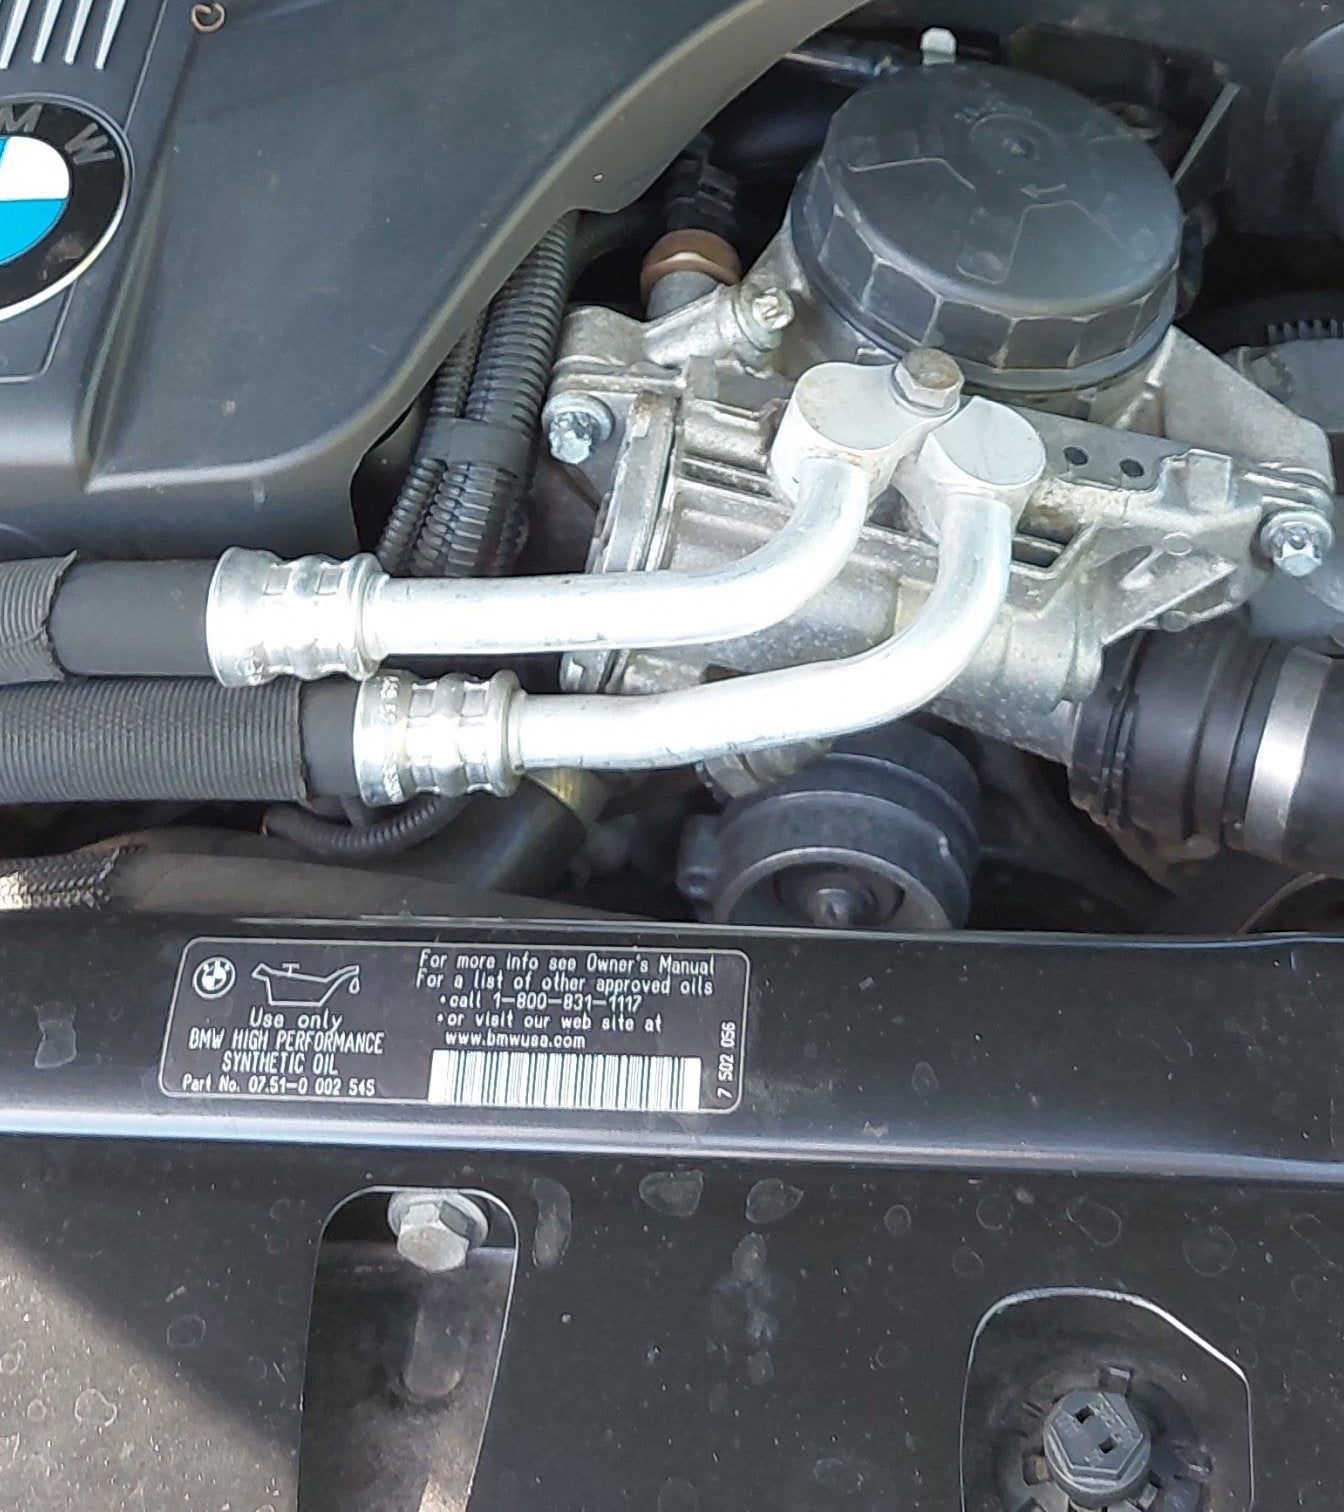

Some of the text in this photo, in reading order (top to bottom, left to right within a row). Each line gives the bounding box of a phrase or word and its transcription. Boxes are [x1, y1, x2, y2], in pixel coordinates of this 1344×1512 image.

[419, 949, 447, 969] For
[457, 954, 495, 970] more
[549, 956, 576, 972] see
[587, 954, 648, 974] Owner's
[659, 955, 715, 976] Manual
[416, 970, 713, 997] For a list of other approved oils
[493, 993, 643, 1013] 1-800-831-1117
[249, 1006, 342, 1033] Use only
[476, 1010, 513, 1029] visit
[525, 1014, 552, 1028] our
[560, 1013, 591, 1030] web
[602, 1014, 636, 1031] site
[645, 1014, 662, 1032] at
[188, 1030, 384, 1054] BMW HIGH PERFORMANCE
[445, 1031, 586, 1048] www.bmwusa.com
[222, 1051, 339, 1074] SYNTHETIC OIL
[182, 1075, 215, 1092] Part
[219, 1076, 240, 1093] No.
[315, 1078, 342, 1095] 002
[717, 1087, 732, 1099] 7
